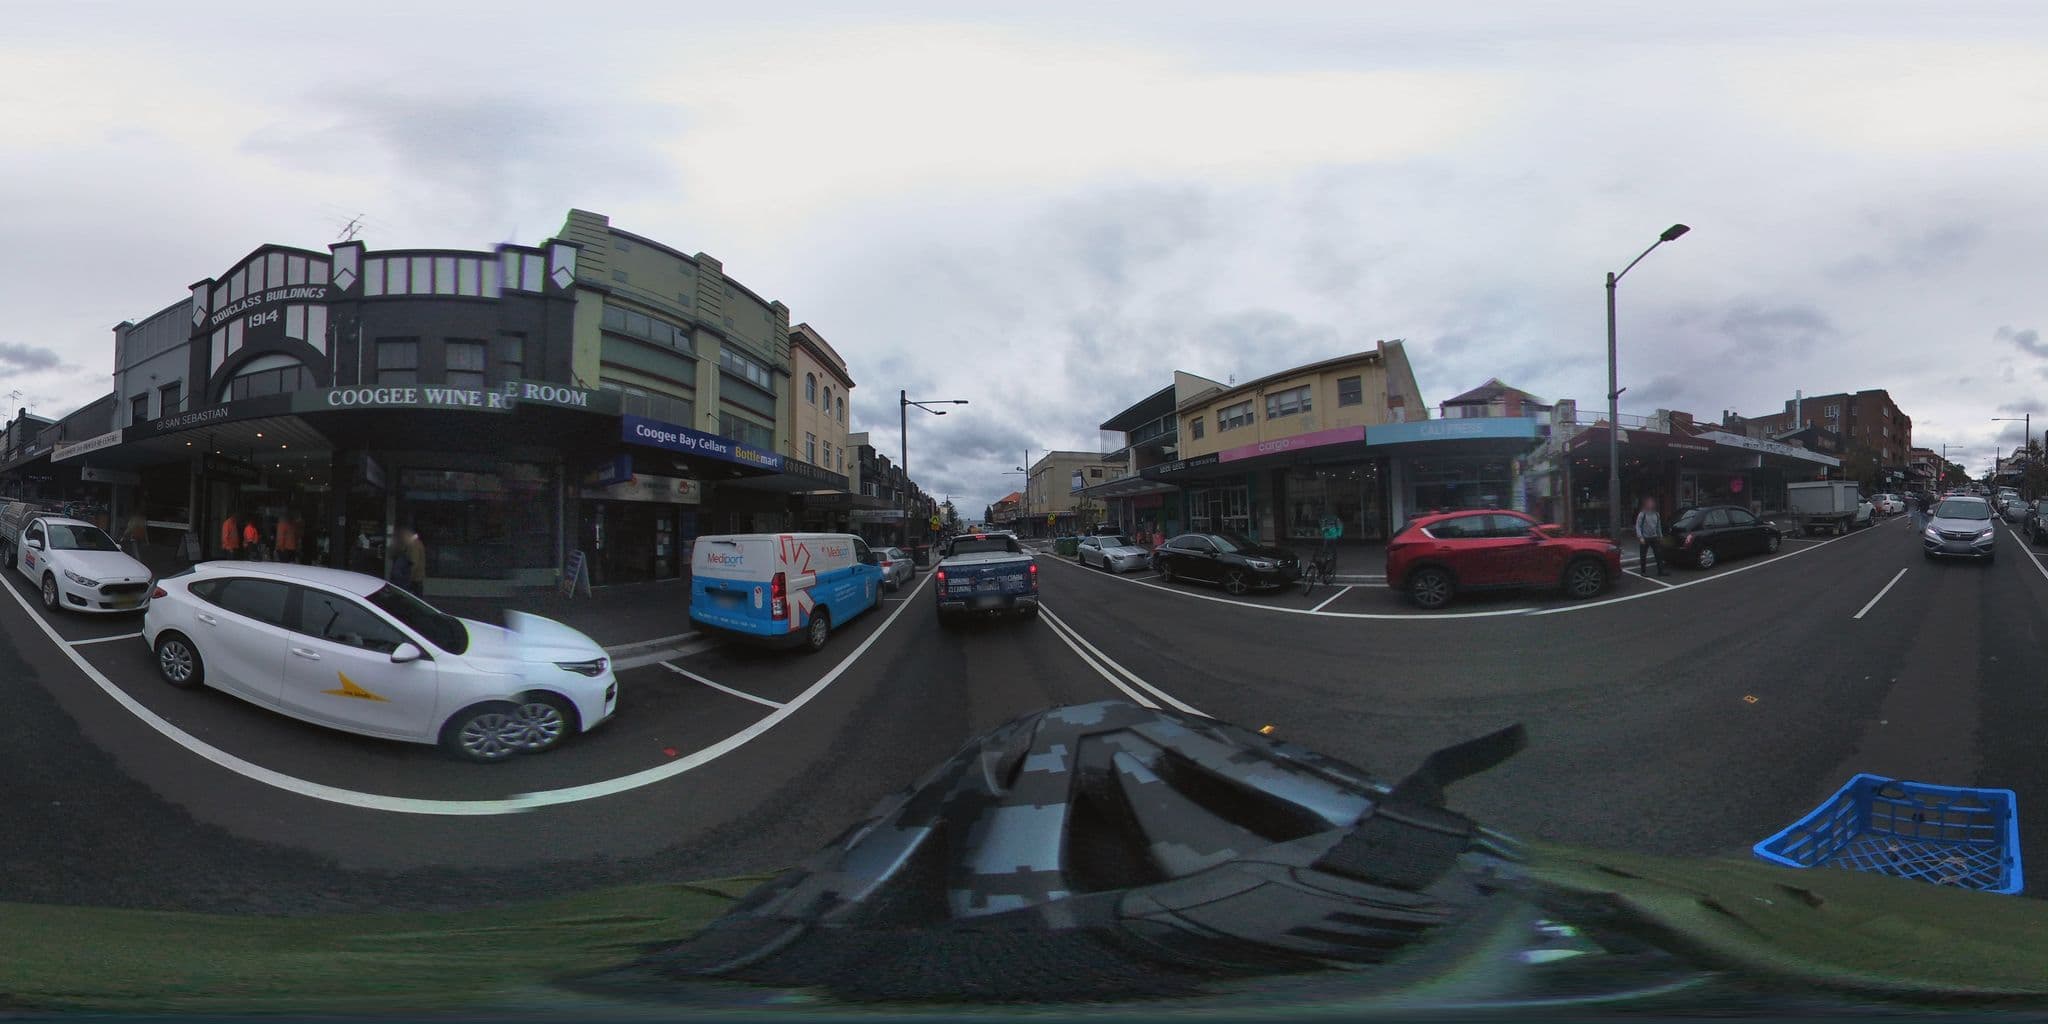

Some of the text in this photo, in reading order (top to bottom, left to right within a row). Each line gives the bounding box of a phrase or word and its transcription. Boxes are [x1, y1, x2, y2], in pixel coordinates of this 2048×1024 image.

[248, 309, 279, 328] 1914
[328, 388, 417, 406] COOGEE
[424, 388, 483, 407] WINE
[525, 383, 588, 407] ROOM
[165, 407, 228, 429] SAN SEBASTIAN
[636, 424, 778, 467] Coogee Bay Cellars Bottlemart
[1258, 438, 1290, 452] cargo
[707, 553, 744, 566] Mediport
